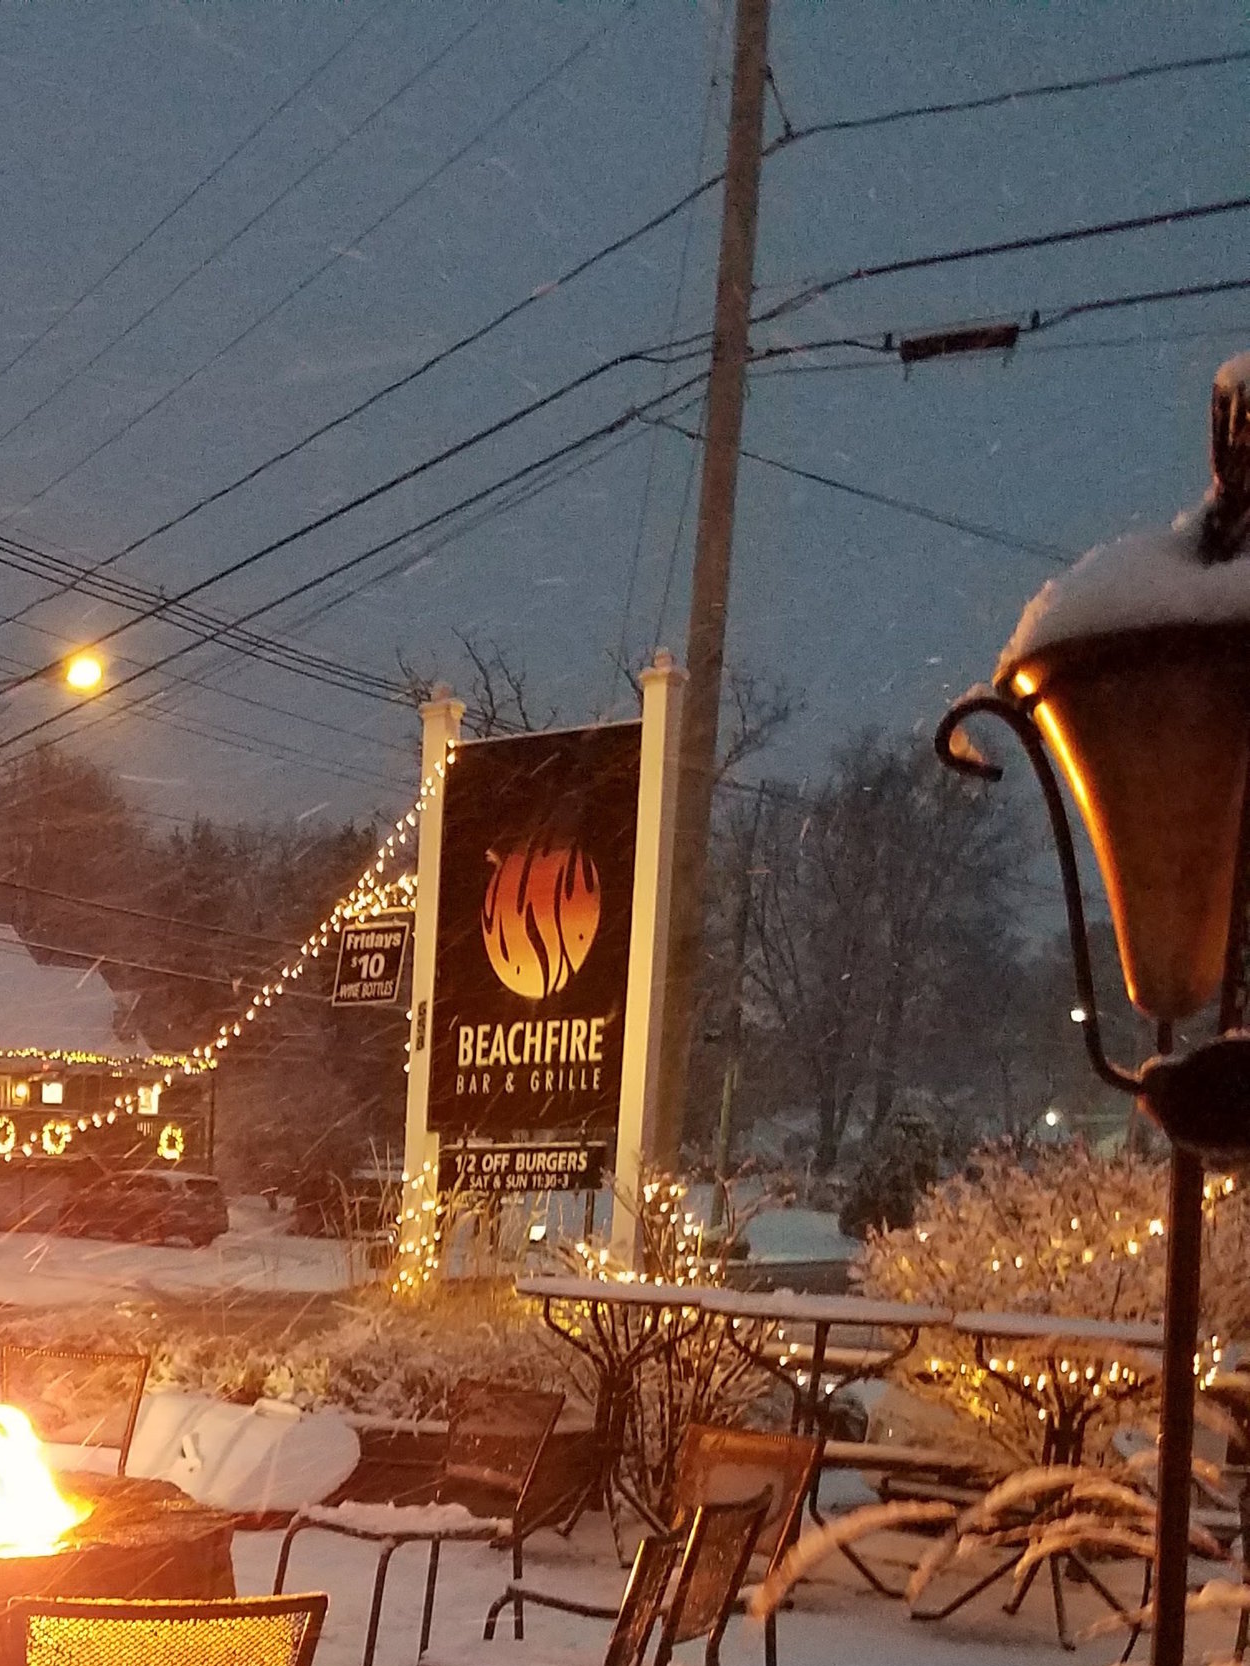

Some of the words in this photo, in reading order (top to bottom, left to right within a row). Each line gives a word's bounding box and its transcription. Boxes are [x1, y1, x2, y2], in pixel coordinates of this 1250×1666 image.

[346, 932, 402, 950] Fridays
[351, 953, 385, 979] $10
[458, 1018, 605, 1067] BEACHFIRE
[456, 1073, 491, 1095] BAR
[505, 1072, 515, 1094] &
[530, 1067, 601, 1092] GRILLE
[455, 1154, 477, 1173] 1/2
[481, 1154, 510, 1173] OFF
[515, 1151, 588, 1172] BURGERS
[469, 1175, 491, 1189] SAT
[505, 1174, 528, 1189] SUN
